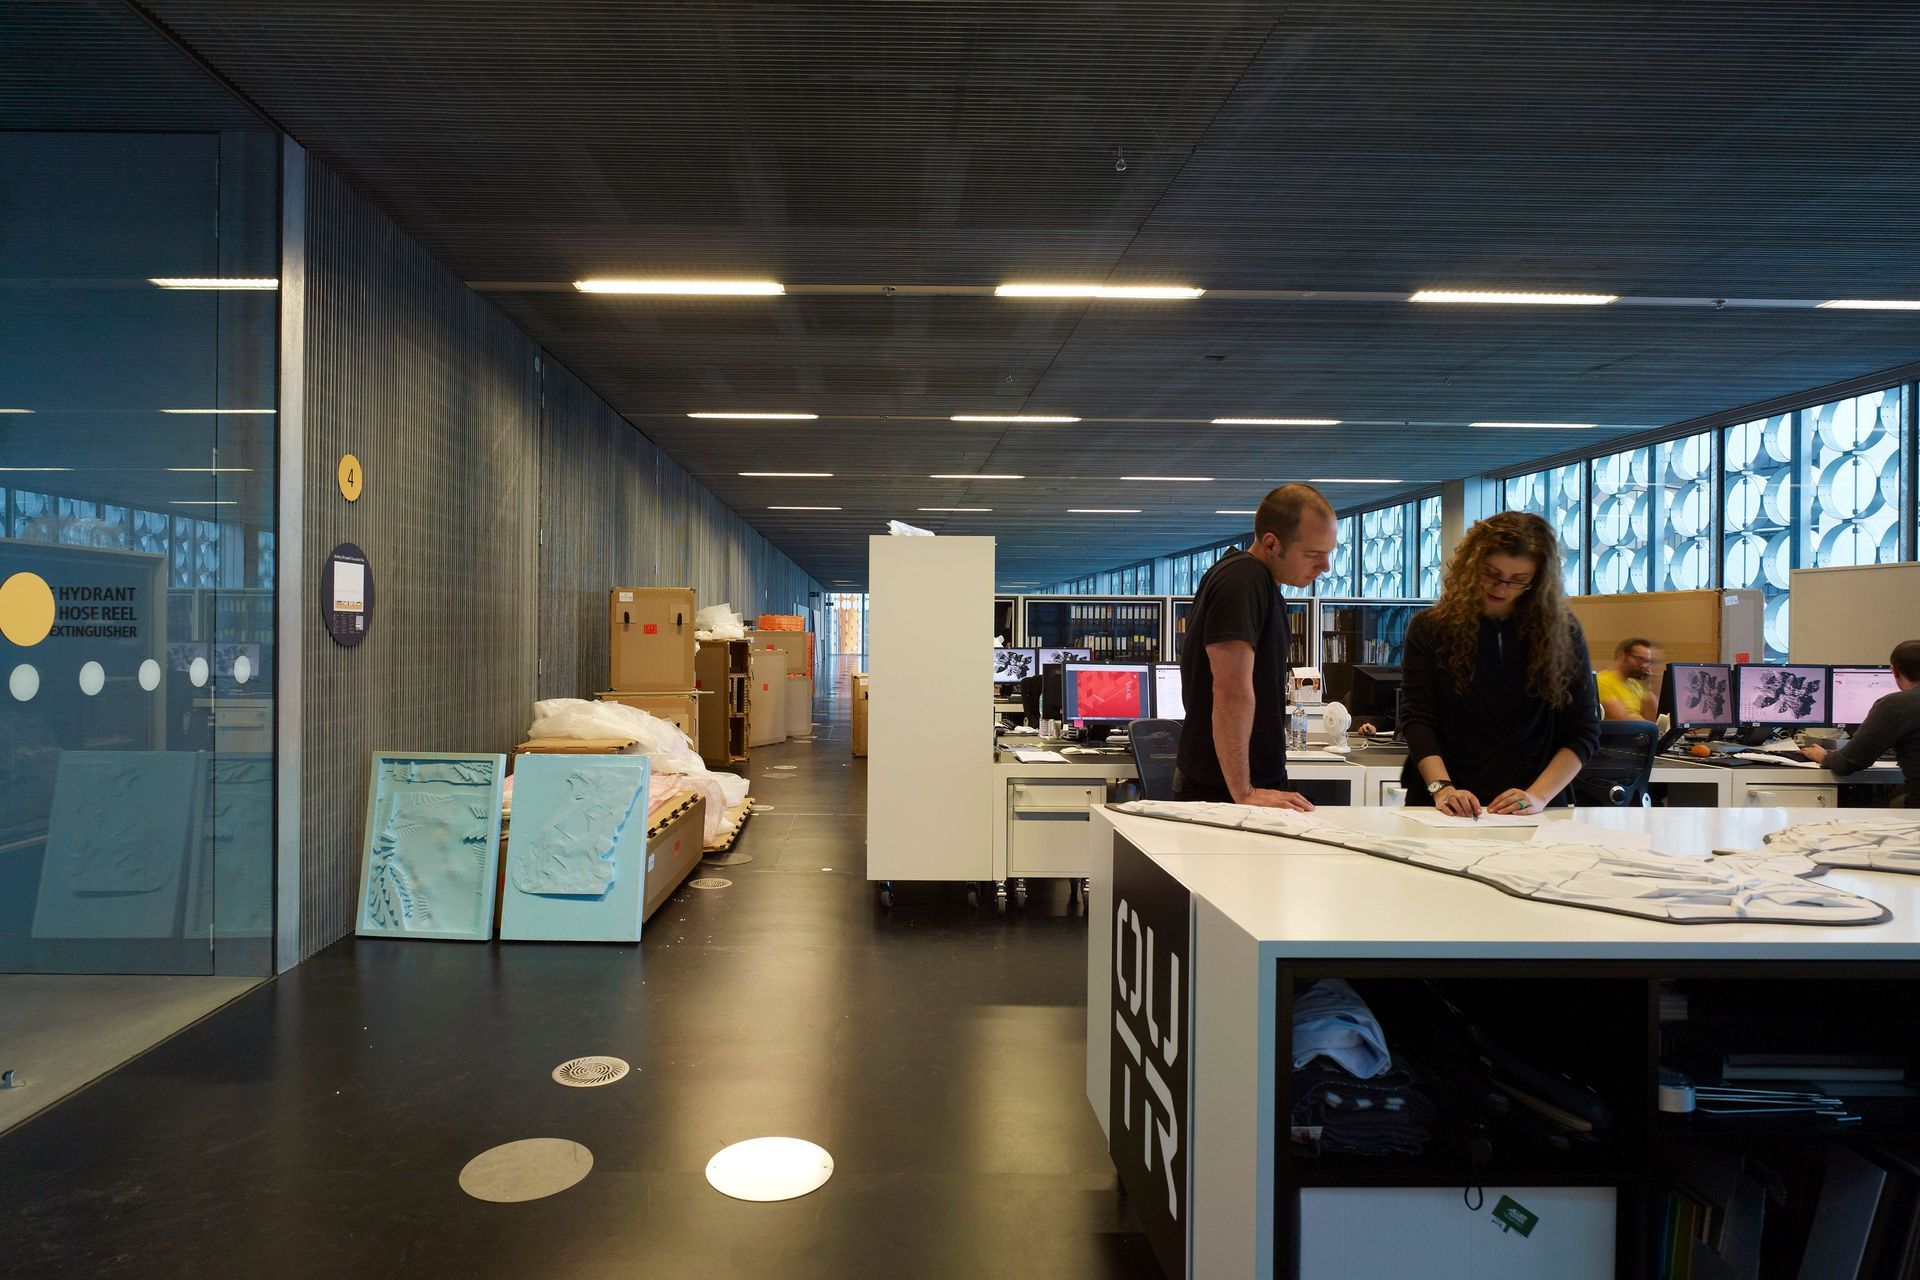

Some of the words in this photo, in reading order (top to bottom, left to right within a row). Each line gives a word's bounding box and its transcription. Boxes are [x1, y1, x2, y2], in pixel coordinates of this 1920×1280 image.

[347, 468, 354, 487] 4
[59, 587, 136, 601] HYDRANT
[59, 606, 98, 620] HOSE
[101, 606, 137, 620] REEL
[50, 625, 137, 637] EXTINGUISHER
